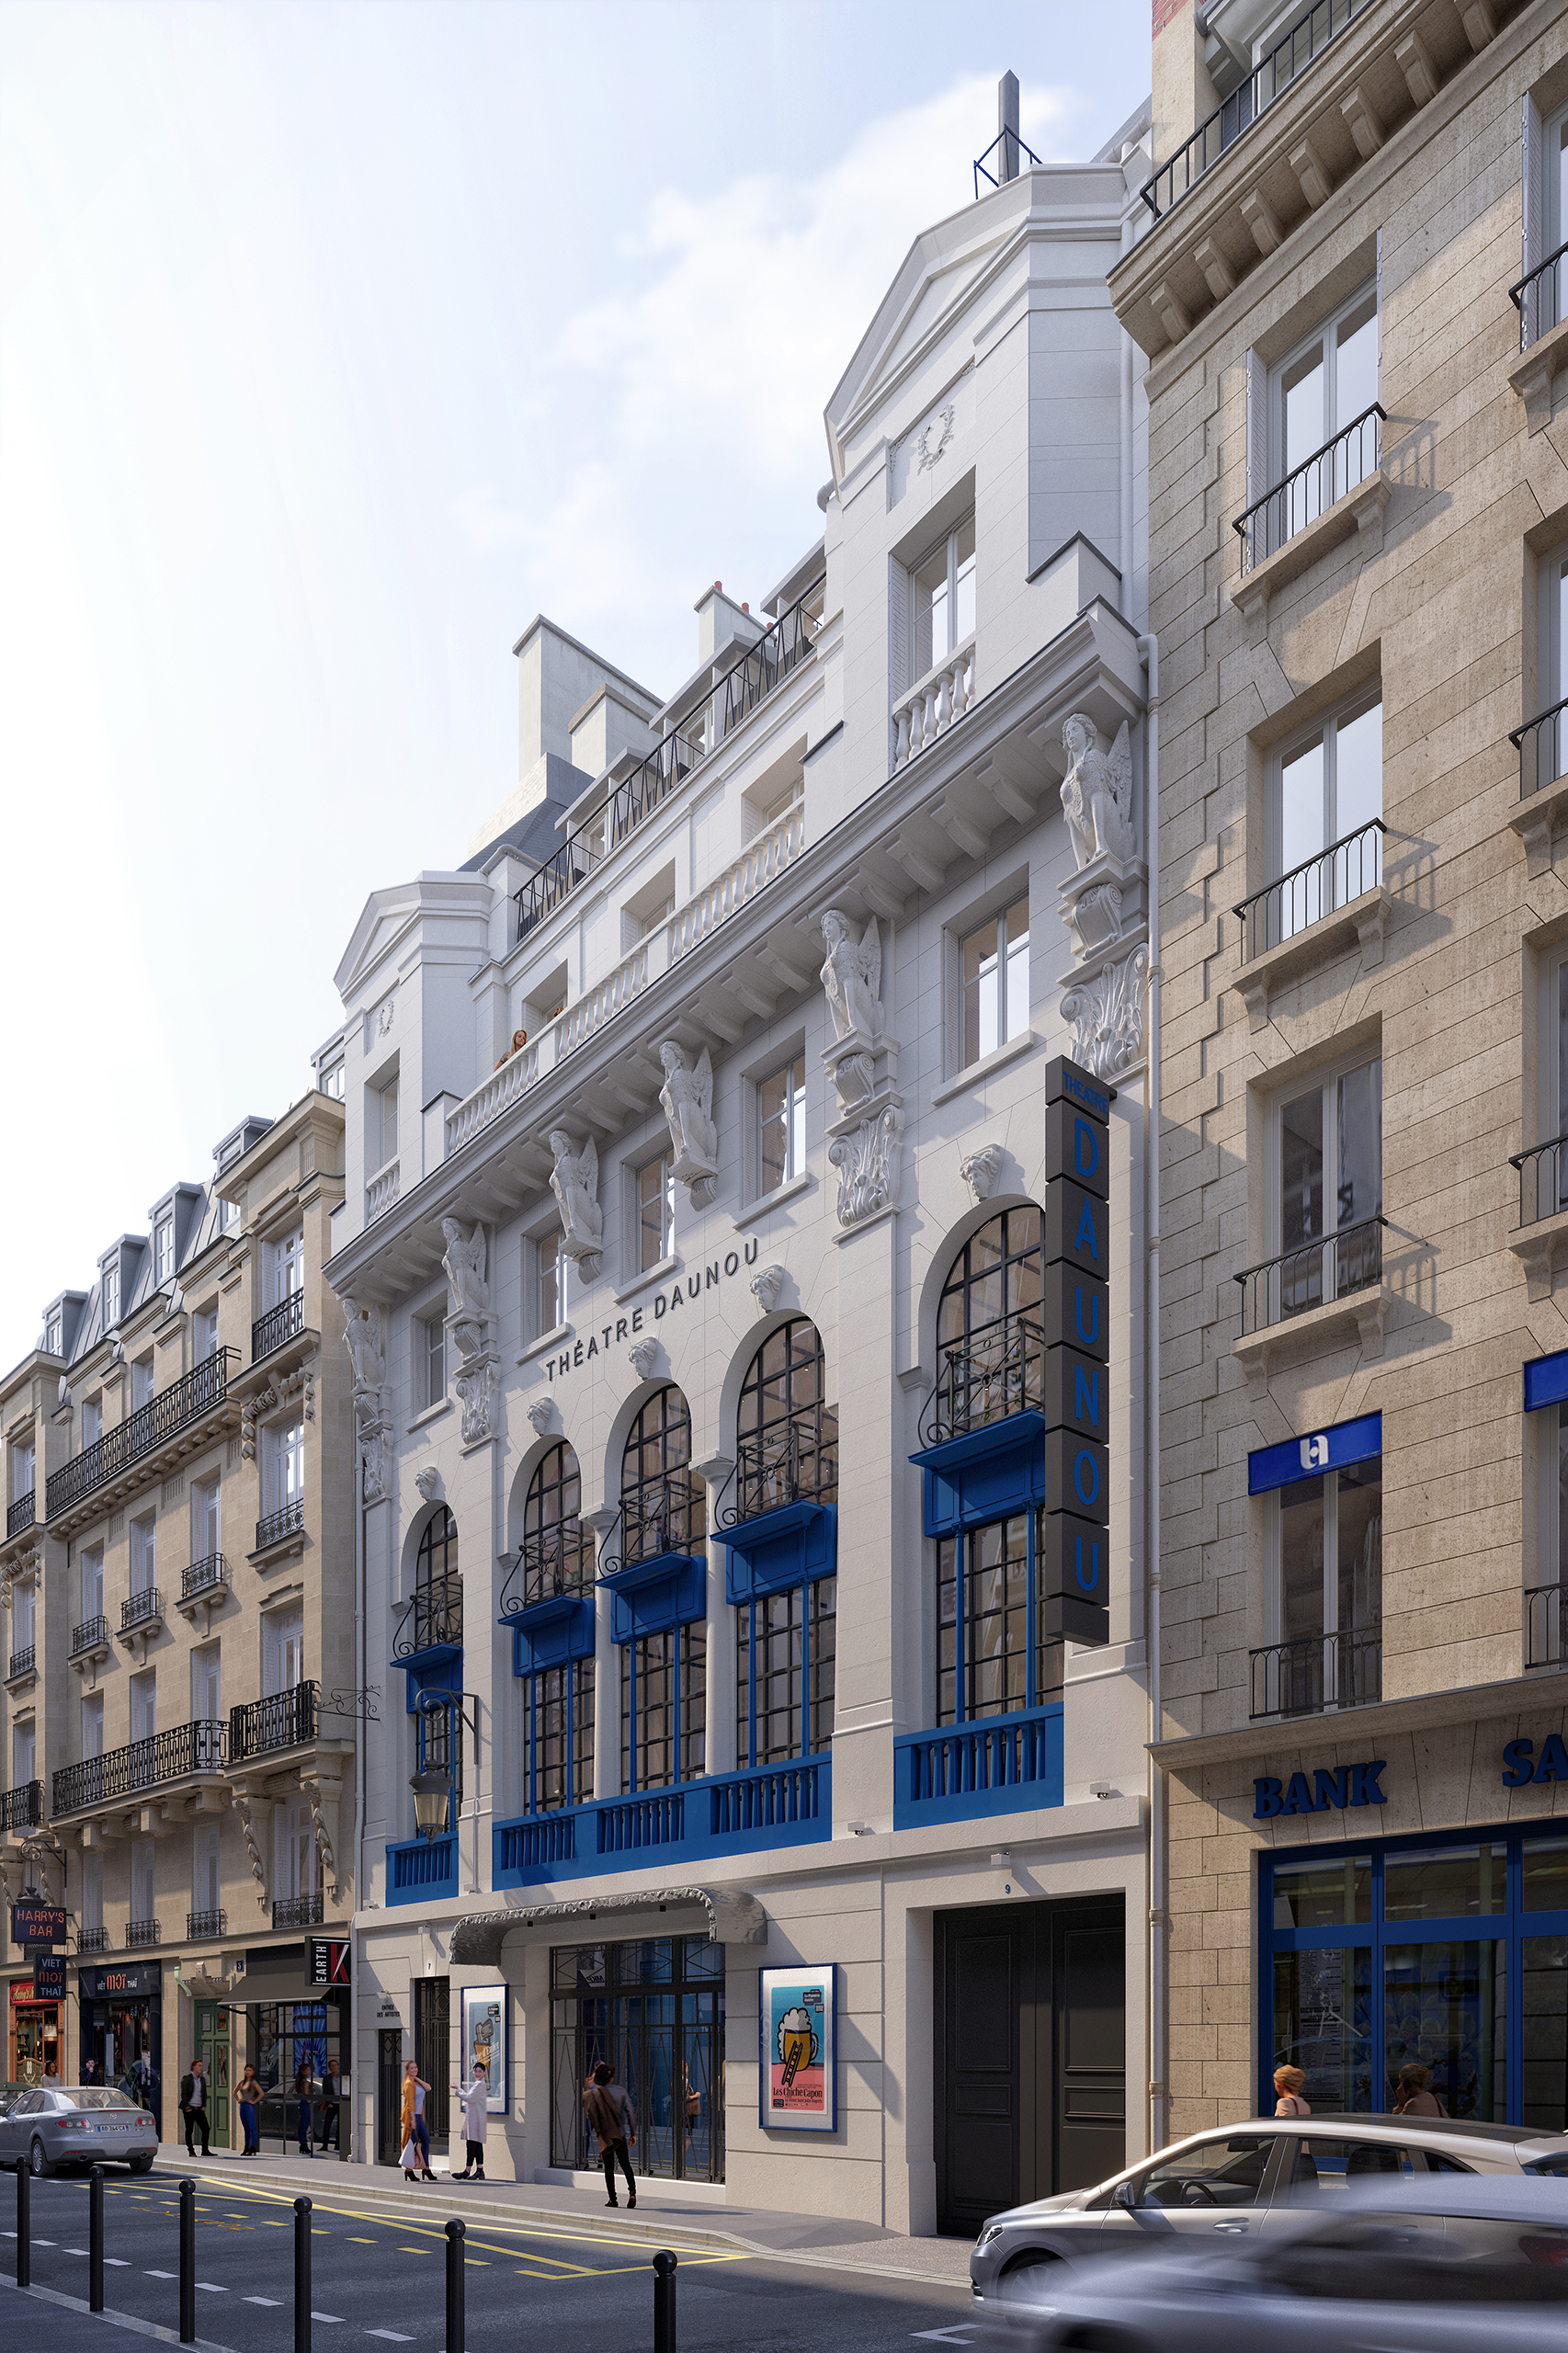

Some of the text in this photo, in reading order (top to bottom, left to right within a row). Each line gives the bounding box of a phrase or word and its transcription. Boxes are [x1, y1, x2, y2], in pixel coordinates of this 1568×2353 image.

[1063, 1071, 1108, 1116] THEATRE
[546, 1238, 758, 1381] THÉATRE DAUNOU
[1074, 1117, 1099, 1592] DAUNOU
[1253, 1759, 1388, 1819] BANK
[1005, 1884, 1011, 1894] 9
[17, 1909, 64, 1924] HARRY'S
[29, 1924, 53, 1938] BAR
[41, 1958, 61, 1967] VIET
[331, 1943, 350, 1984] K
[40, 1986, 62, 1996] THAÏ
[773, 2086, 823, 2099] Les Chiche Capon
